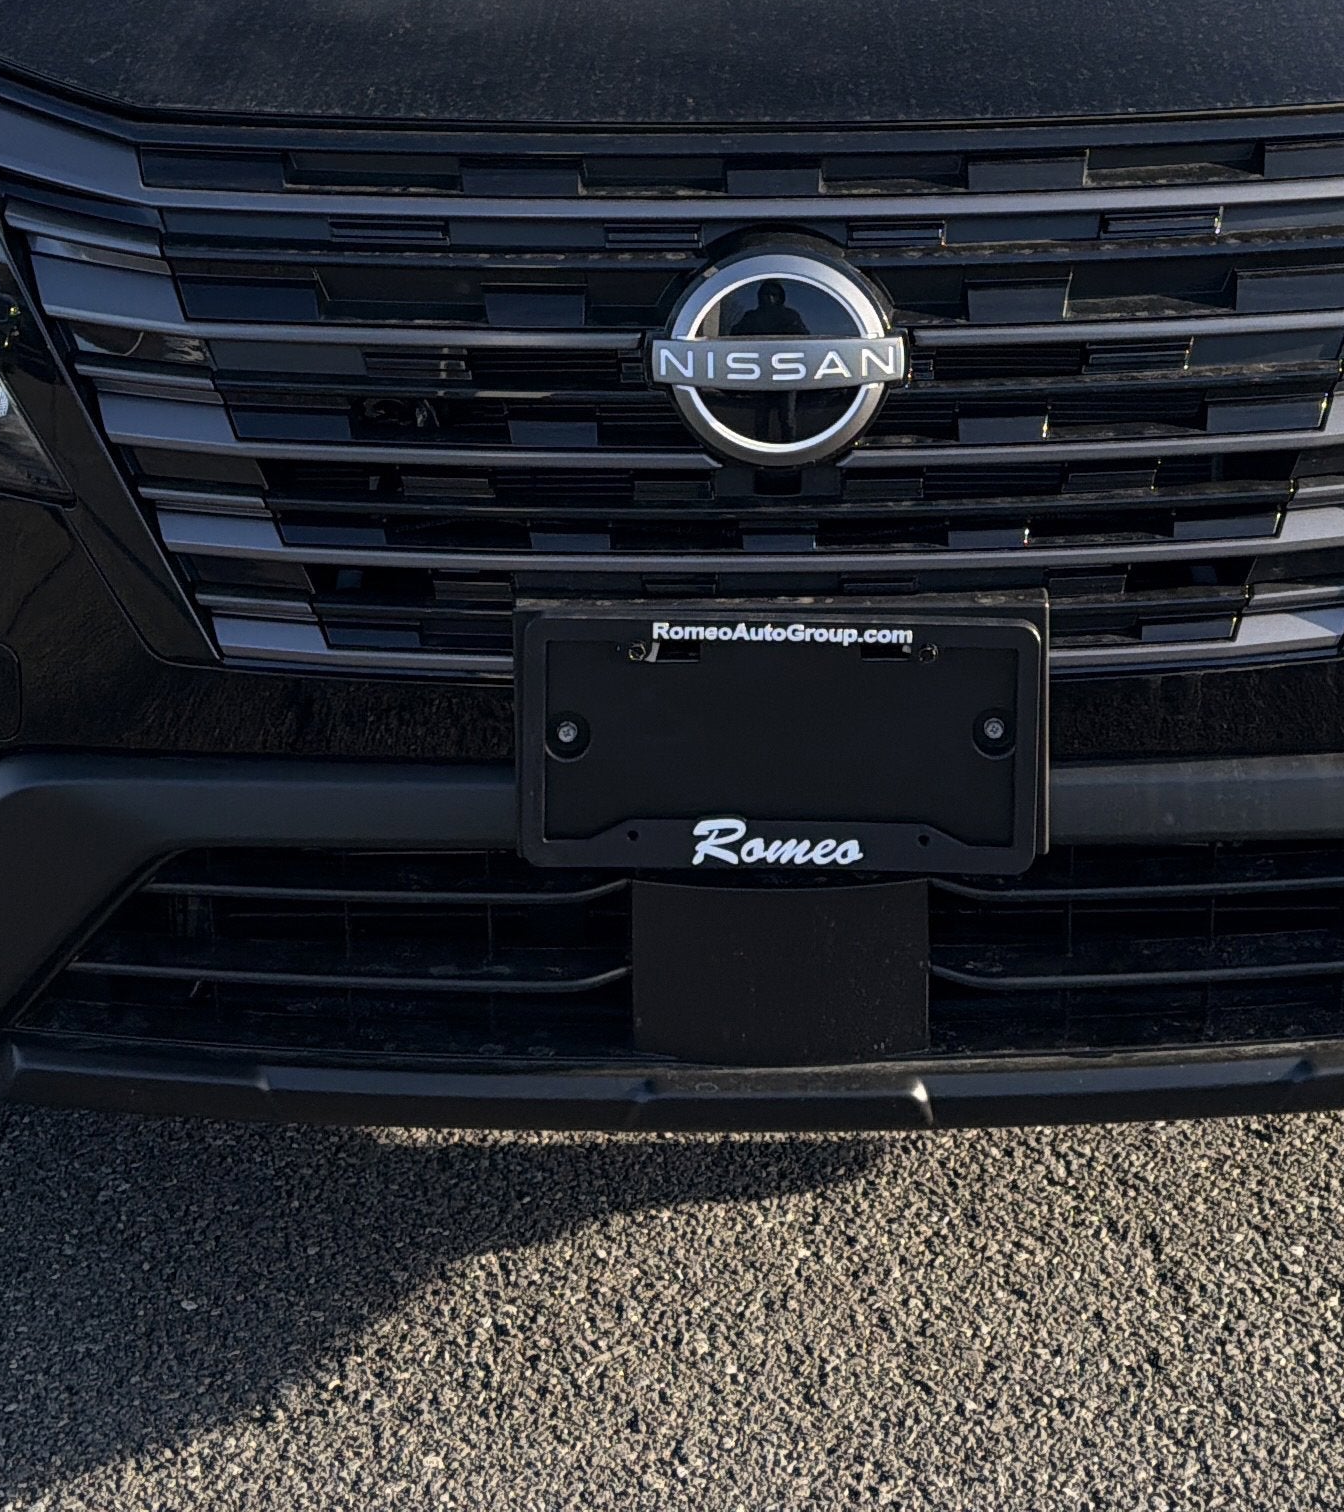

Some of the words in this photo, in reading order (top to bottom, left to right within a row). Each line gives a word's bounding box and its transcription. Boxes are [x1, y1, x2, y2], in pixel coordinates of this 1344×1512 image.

[659, 345, 895, 381] NISSAN
[652, 622, 913, 646] RomeoAutoGroup.com
[691, 817, 864, 866] Romeo
